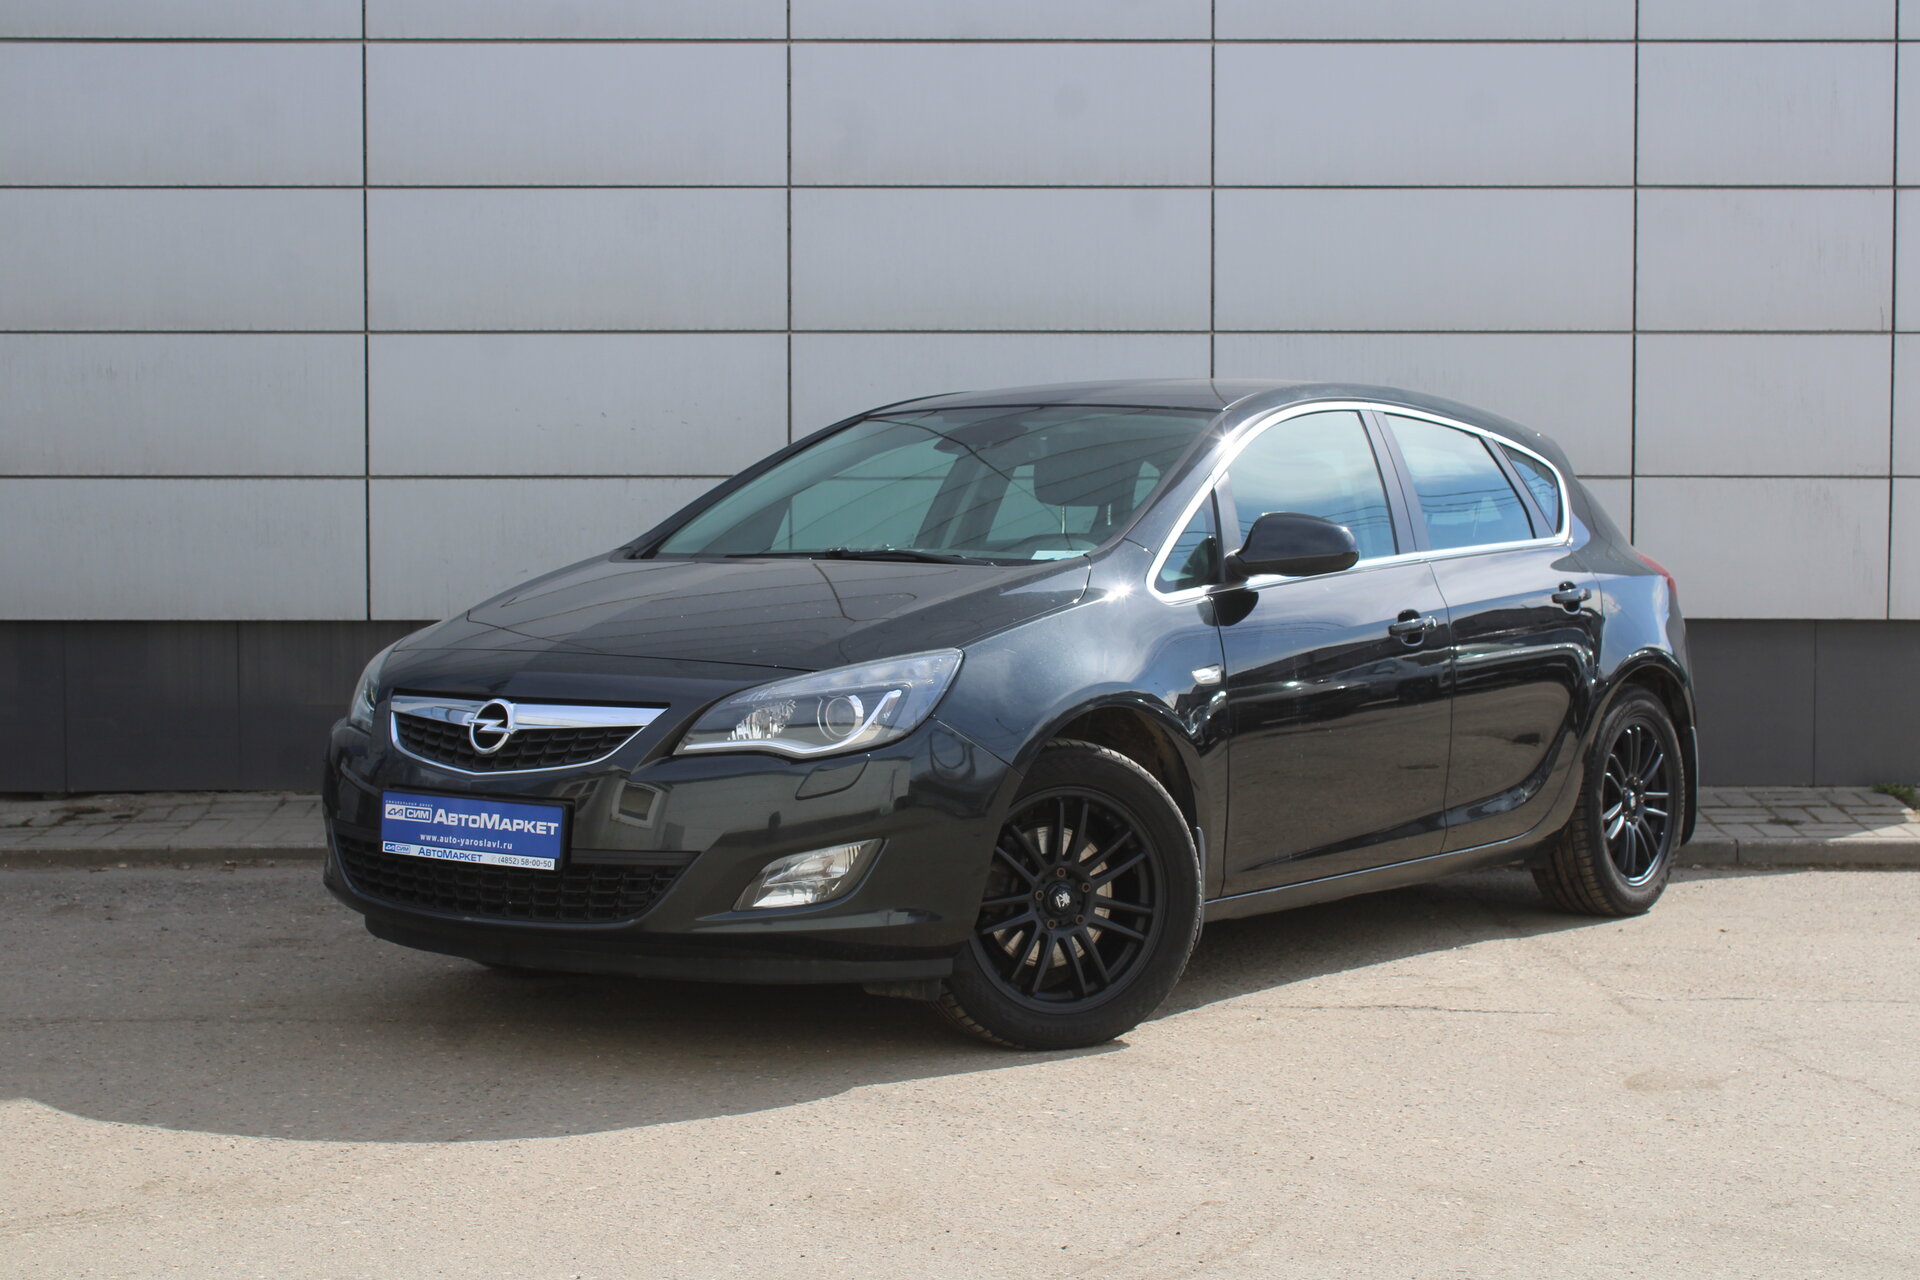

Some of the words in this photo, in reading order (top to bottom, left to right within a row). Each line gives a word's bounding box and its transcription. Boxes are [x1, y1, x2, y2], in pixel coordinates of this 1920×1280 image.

[406, 809, 429, 819] СИМ
[420, 833, 513, 850] www.auto-yaroslavl.ru
[498, 856, 519, 865] (4852)
[521, 858, 552, 868] 58-00-50
